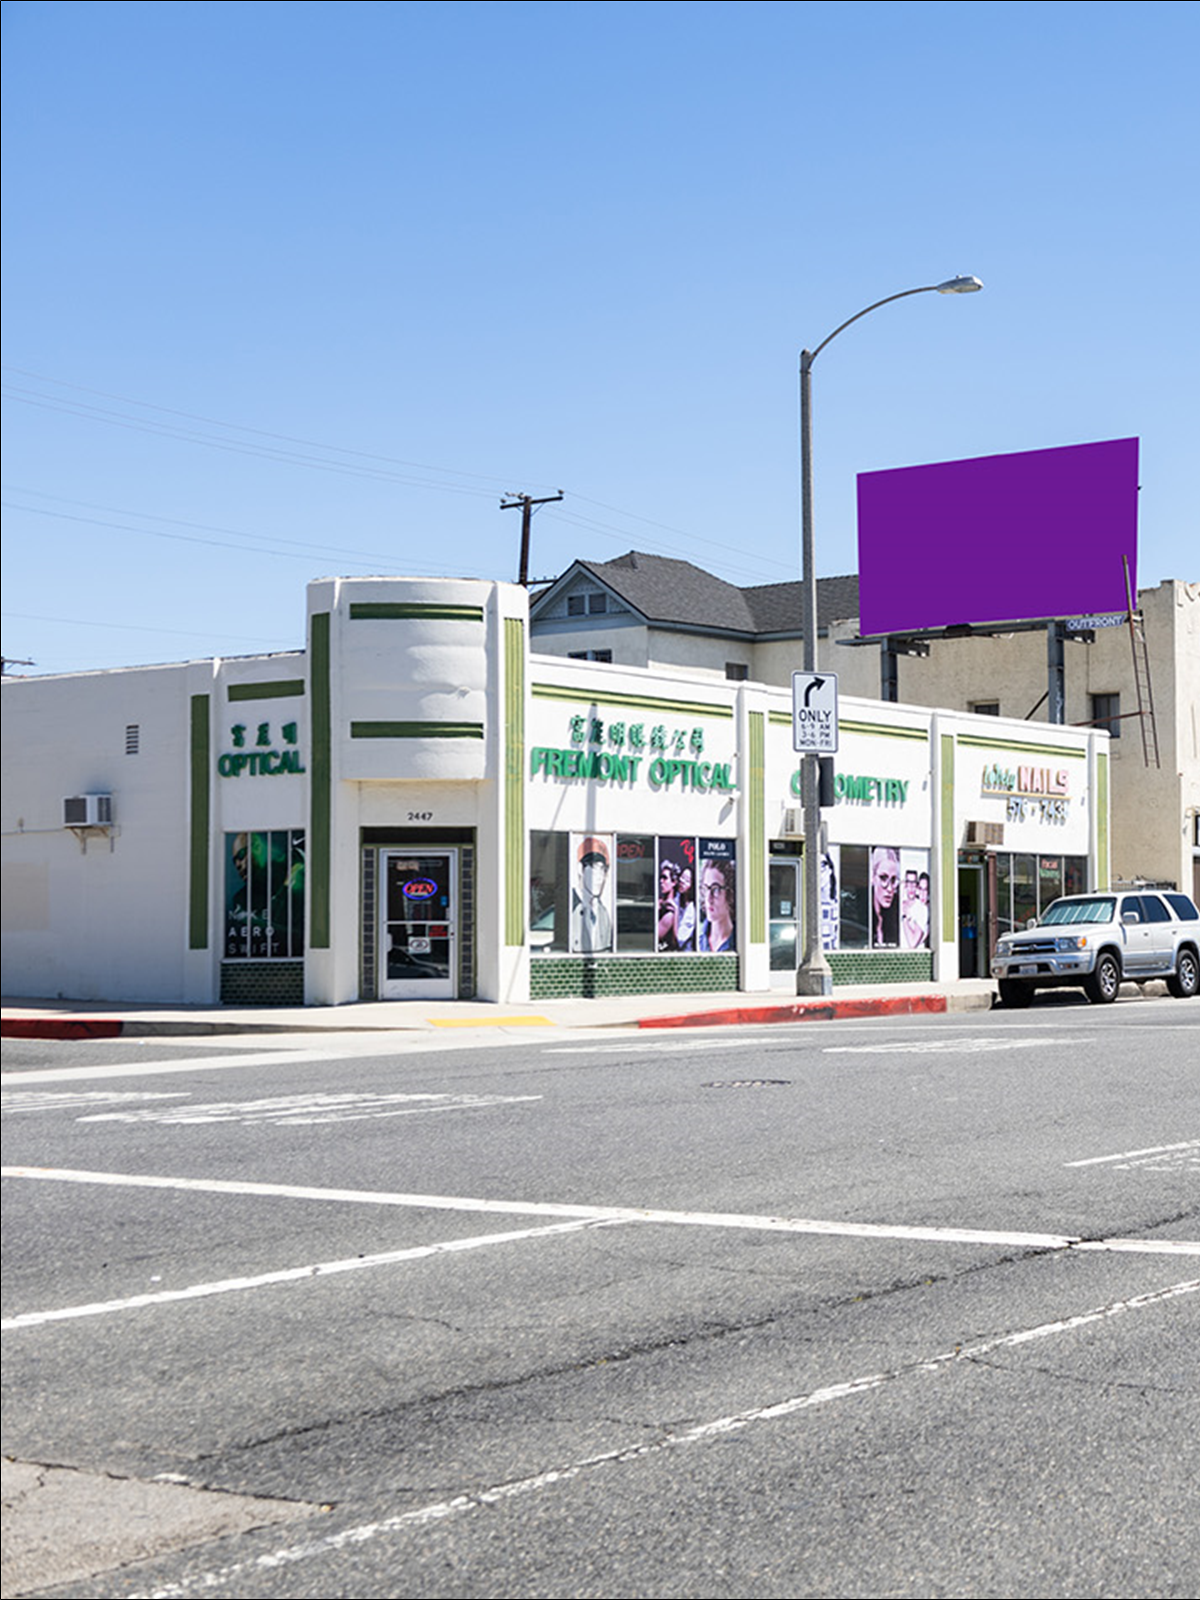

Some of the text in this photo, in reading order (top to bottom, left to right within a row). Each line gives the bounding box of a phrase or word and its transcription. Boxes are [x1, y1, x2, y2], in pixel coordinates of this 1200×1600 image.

[799, 709, 831, 722] ONLY
[218, 750, 306, 778] OPTICAL
[531, 747, 737, 789] FREMONT OPTICAL
[791, 769, 909, 803] OOMETRY
[1017, 765, 1069, 796] NAILS
[408, 812, 433, 821] 2447
[617, 844, 645, 859] PEN
[708, 842, 727, 851] POLO
[404, 883, 434, 894] OPEN
[228, 926, 275, 937] AERO
